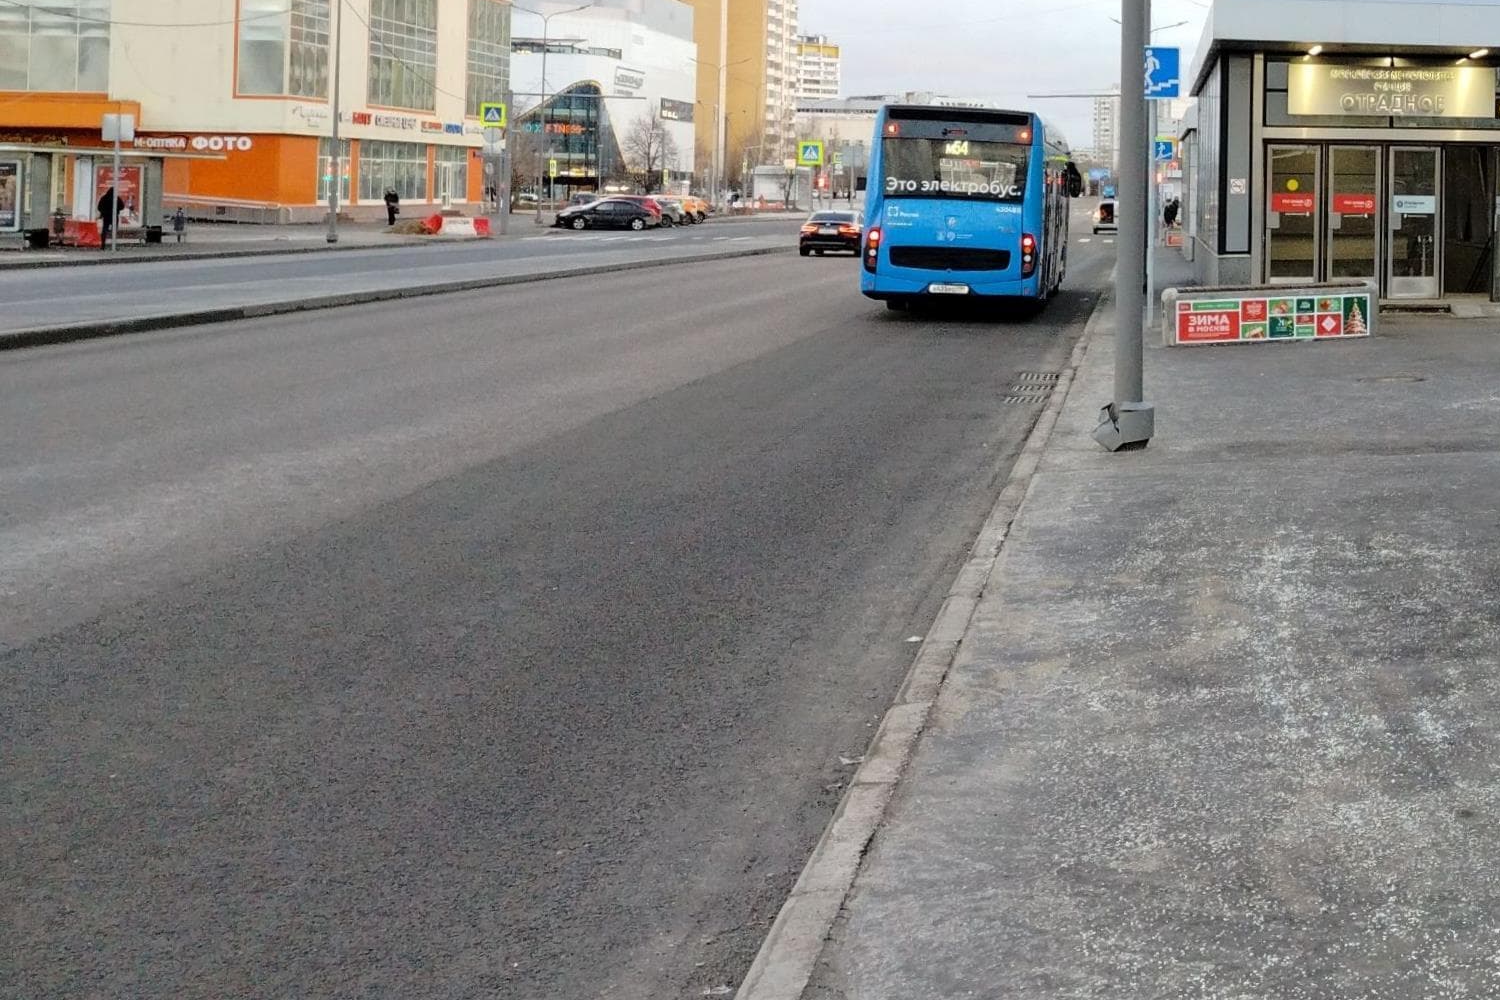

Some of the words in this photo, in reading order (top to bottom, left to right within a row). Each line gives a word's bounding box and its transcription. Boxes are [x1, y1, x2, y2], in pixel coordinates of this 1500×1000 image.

[1340, 93, 1447, 114] ОТРАДНОЕ
[191, 136, 253, 151] ФОТО
[886, 176, 917, 191] Это
[920, 179, 1022, 198] электробус.
[1187, 314, 1230, 326] ЗИМА
